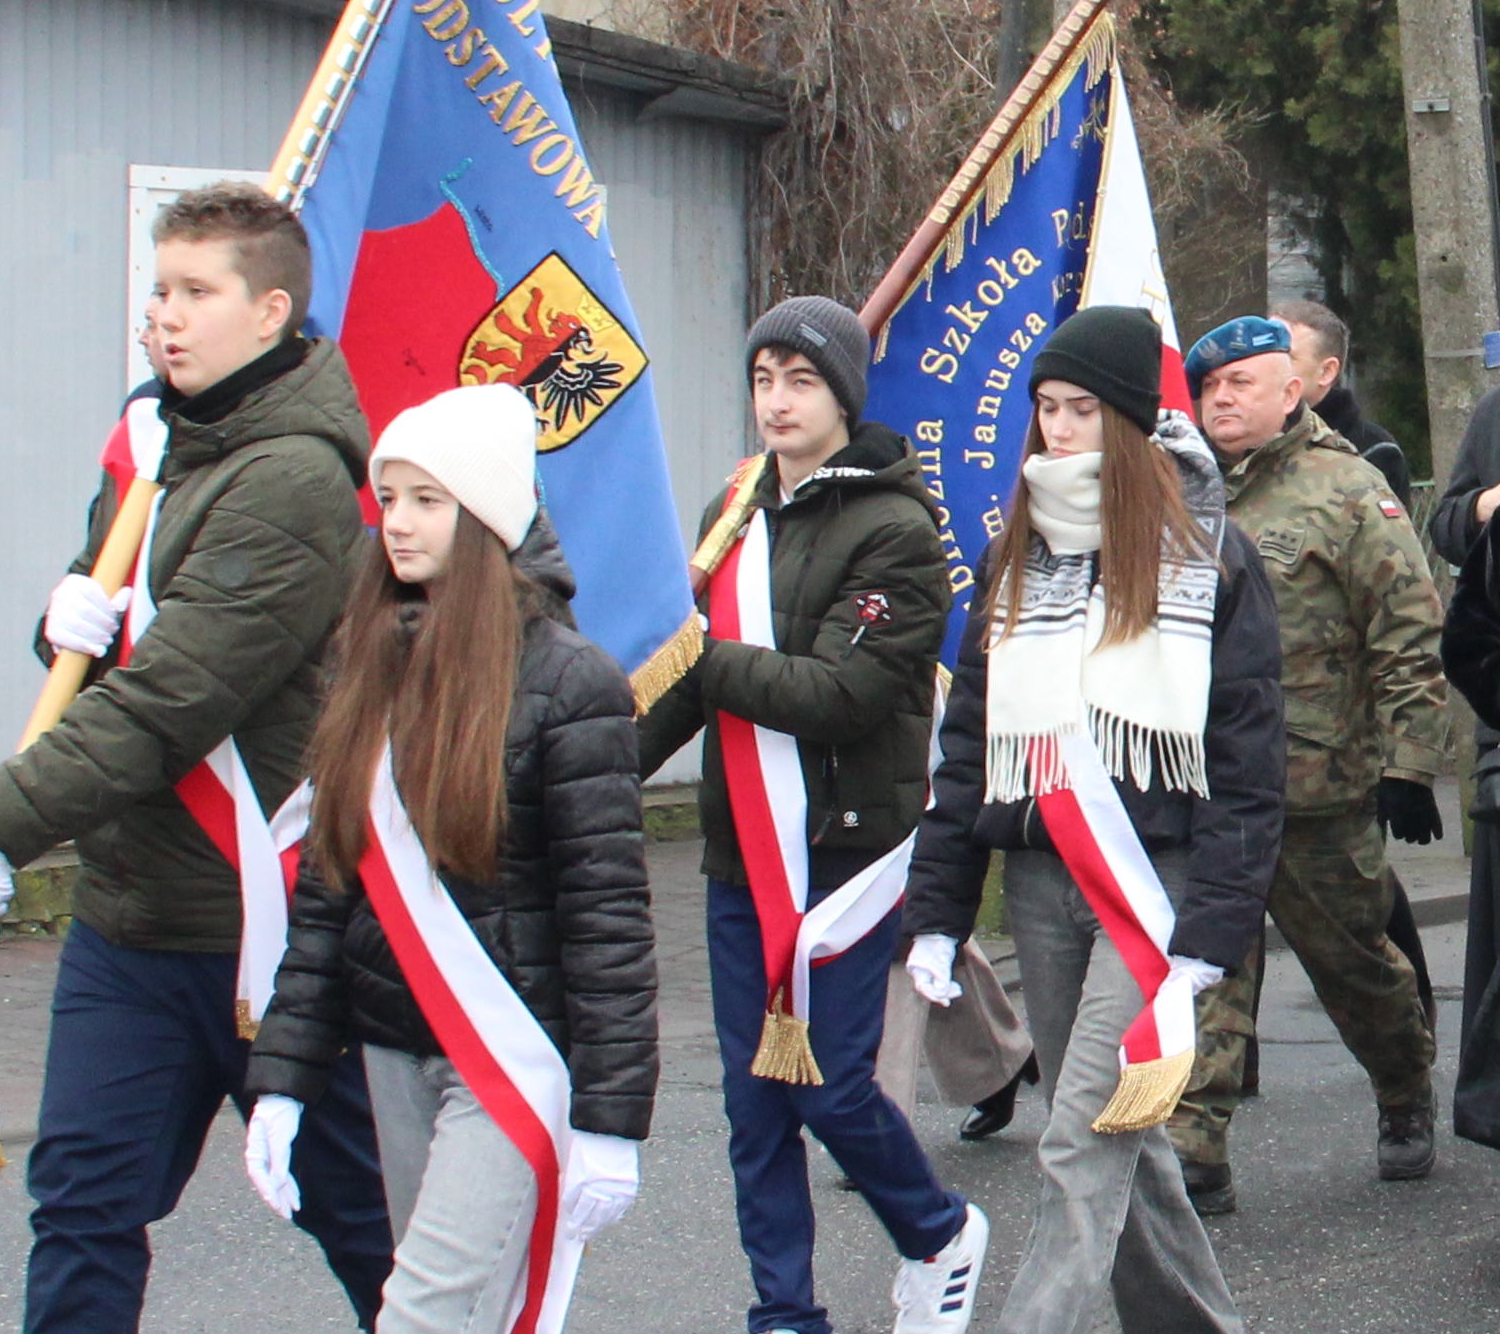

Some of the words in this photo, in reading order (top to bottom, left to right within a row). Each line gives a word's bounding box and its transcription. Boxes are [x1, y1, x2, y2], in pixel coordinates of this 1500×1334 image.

[920, 244, 1043, 384] Szkoła
[964, 310, 1048, 469] Janusza
[982, 493, 1005, 539] m.
